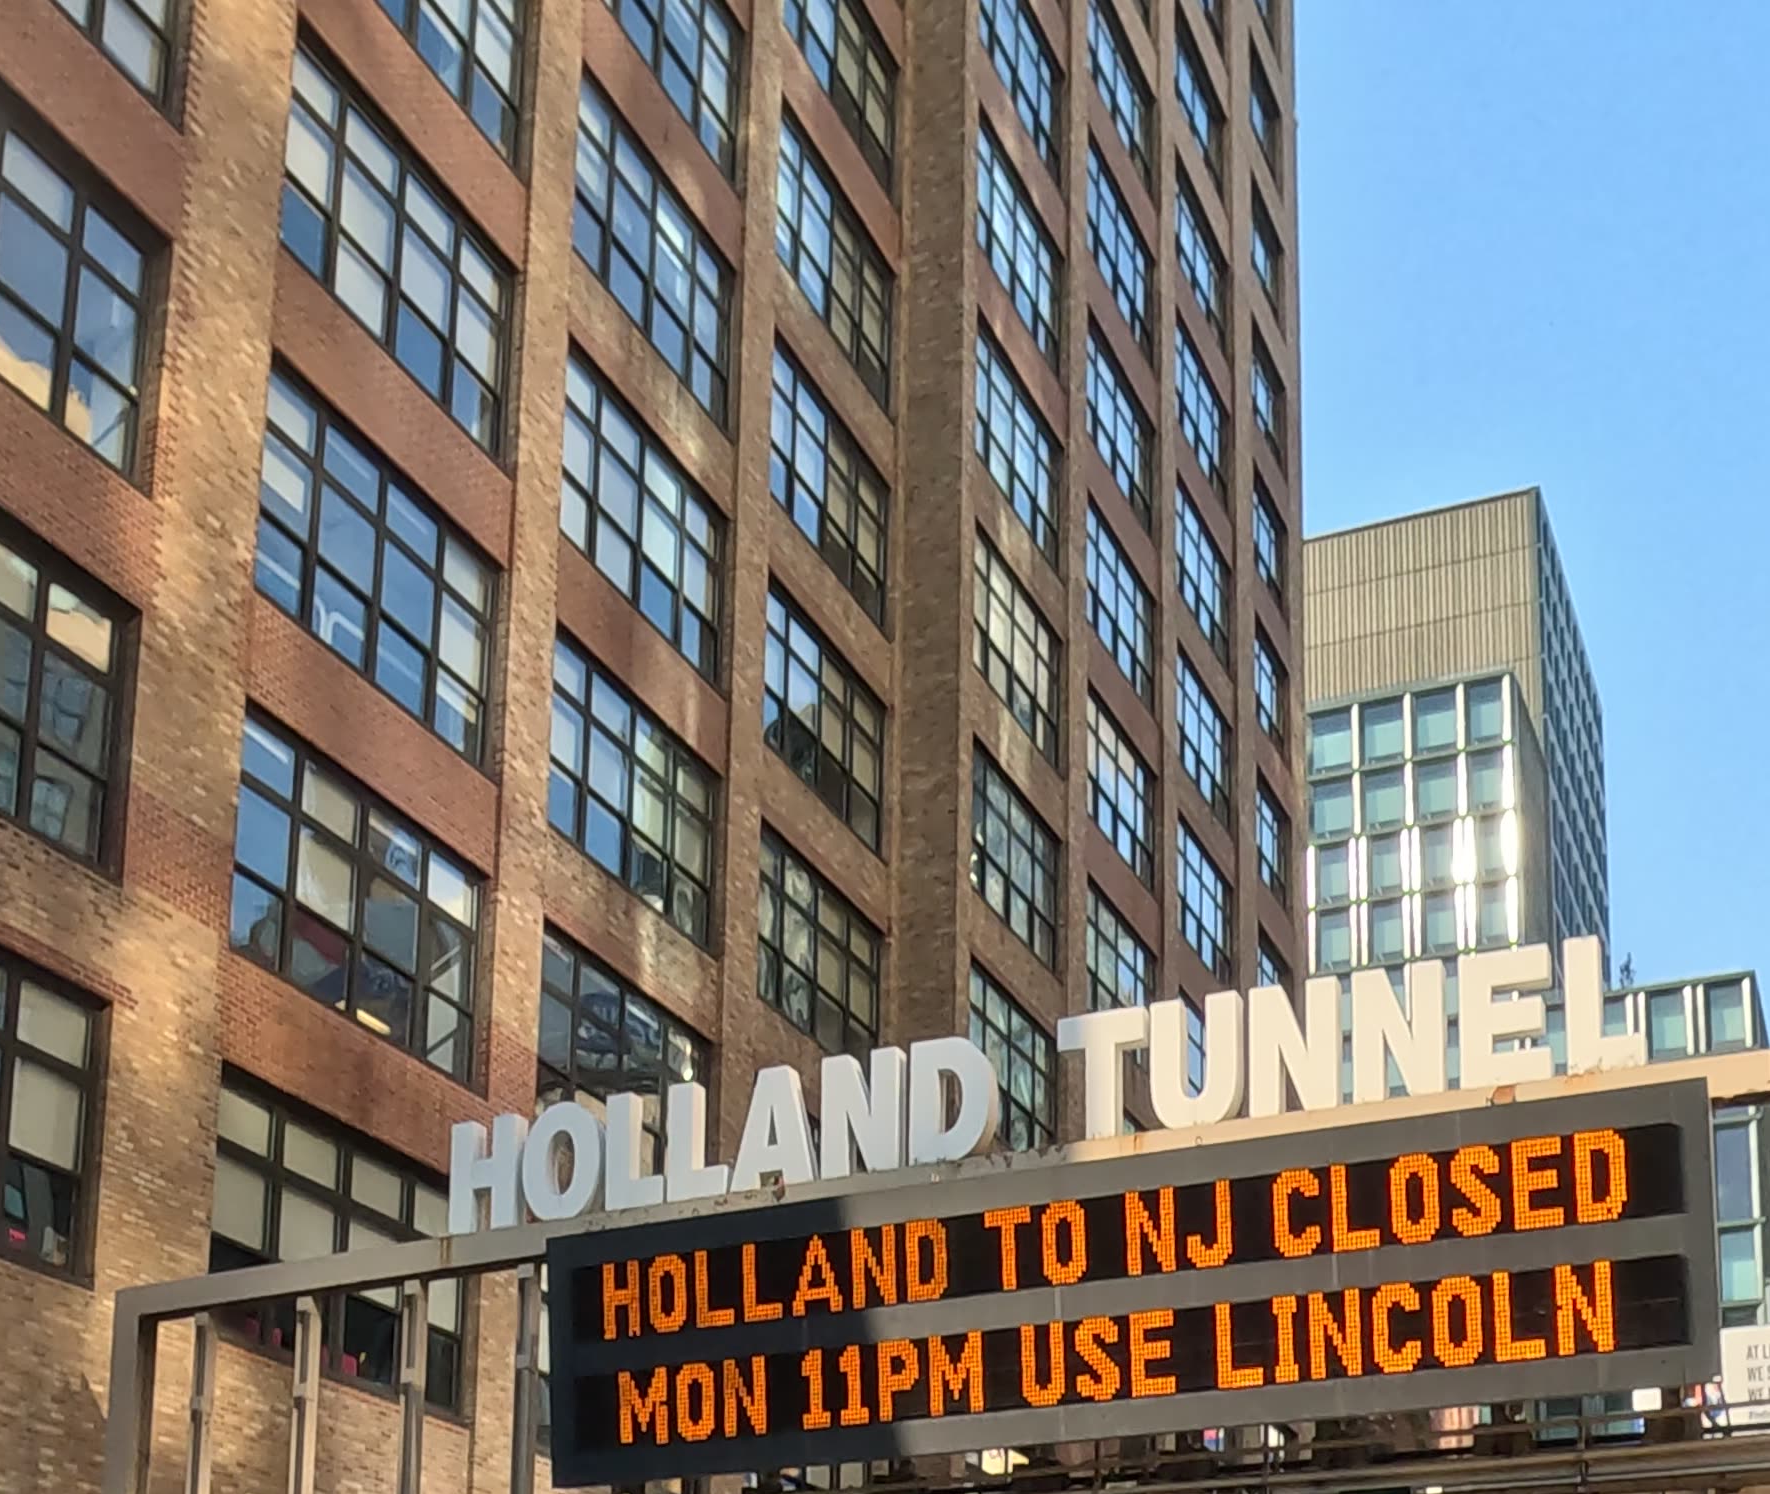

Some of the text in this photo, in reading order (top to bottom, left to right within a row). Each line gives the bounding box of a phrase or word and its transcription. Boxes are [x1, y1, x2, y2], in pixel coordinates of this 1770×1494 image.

[449, 935, 1649, 1234] HOLLAND TUNNEL
[602, 1128, 1628, 1340] HOLLAND TO NJ CLOSED
[617, 1259, 1616, 1445] MON 11PM USE LINCOLN
[1746, 1344, 1760, 1360] AT
[1747, 1366, 1764, 1382] WE
